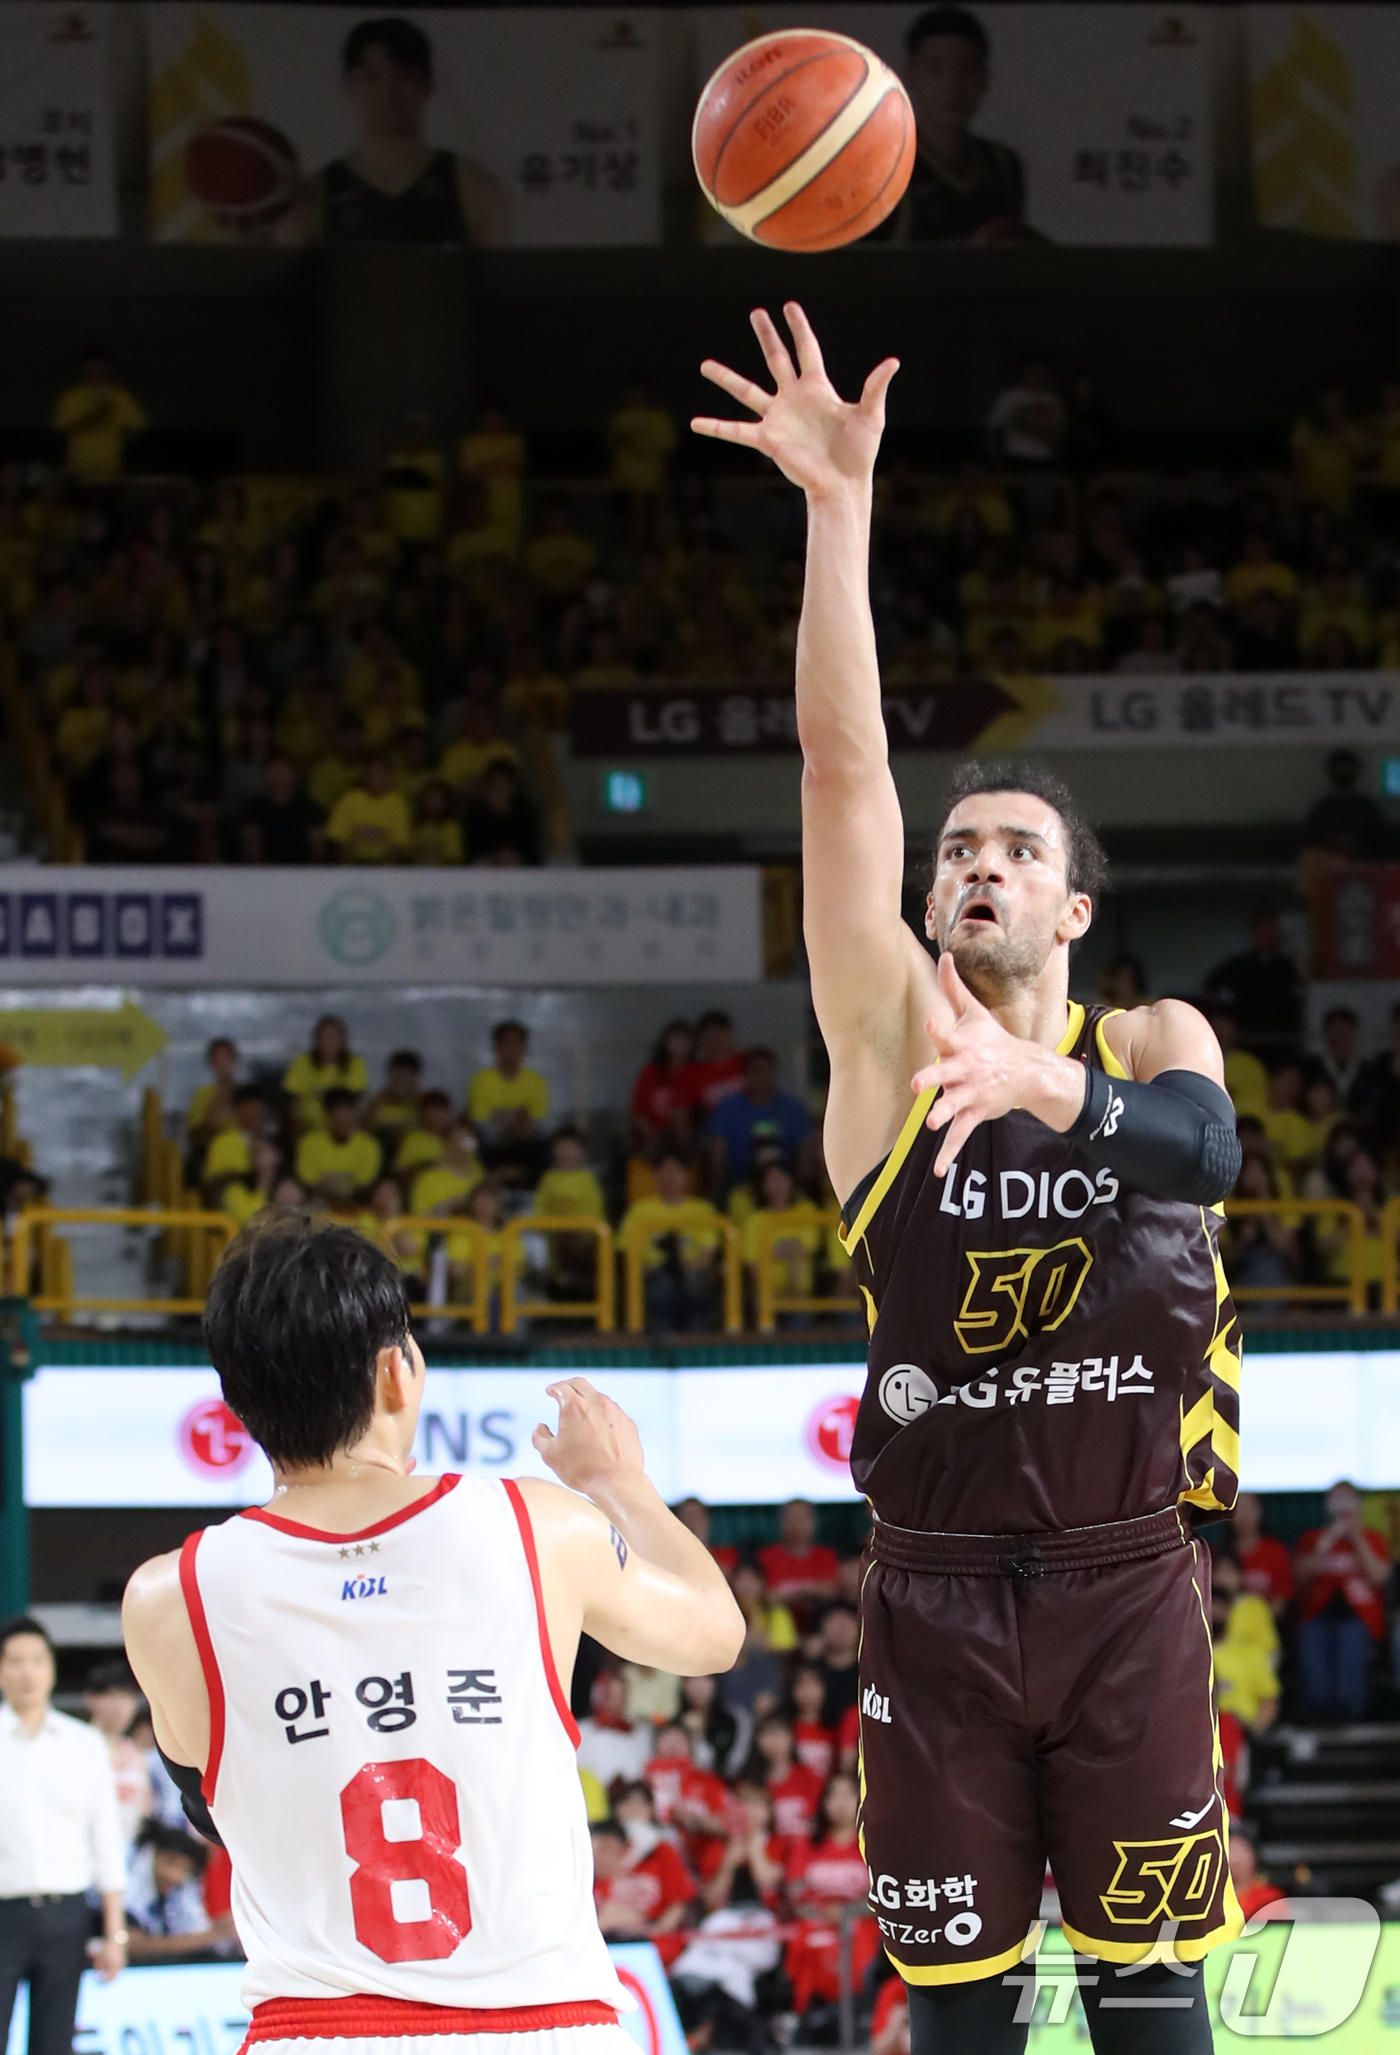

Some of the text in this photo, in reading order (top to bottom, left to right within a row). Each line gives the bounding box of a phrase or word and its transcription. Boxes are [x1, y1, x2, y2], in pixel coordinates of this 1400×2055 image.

[755, 96, 797, 139] FIBA
[627, 701, 700, 744] LG
[1091, 691, 1156, 730] LG
[1323, 688, 1391, 725] TV
[0, 899, 200, 950] ABOX
[939, 1163, 1120, 1219] LG DIOS
[953, 1236, 1094, 1354] 50
[421, 1411, 515, 1464] NS
[341, 1573, 388, 1600] KBL
[862, 1682, 892, 1724] KBL
[339, 1757, 472, 1964] 8
[1099, 1828, 1223, 1925] 50
